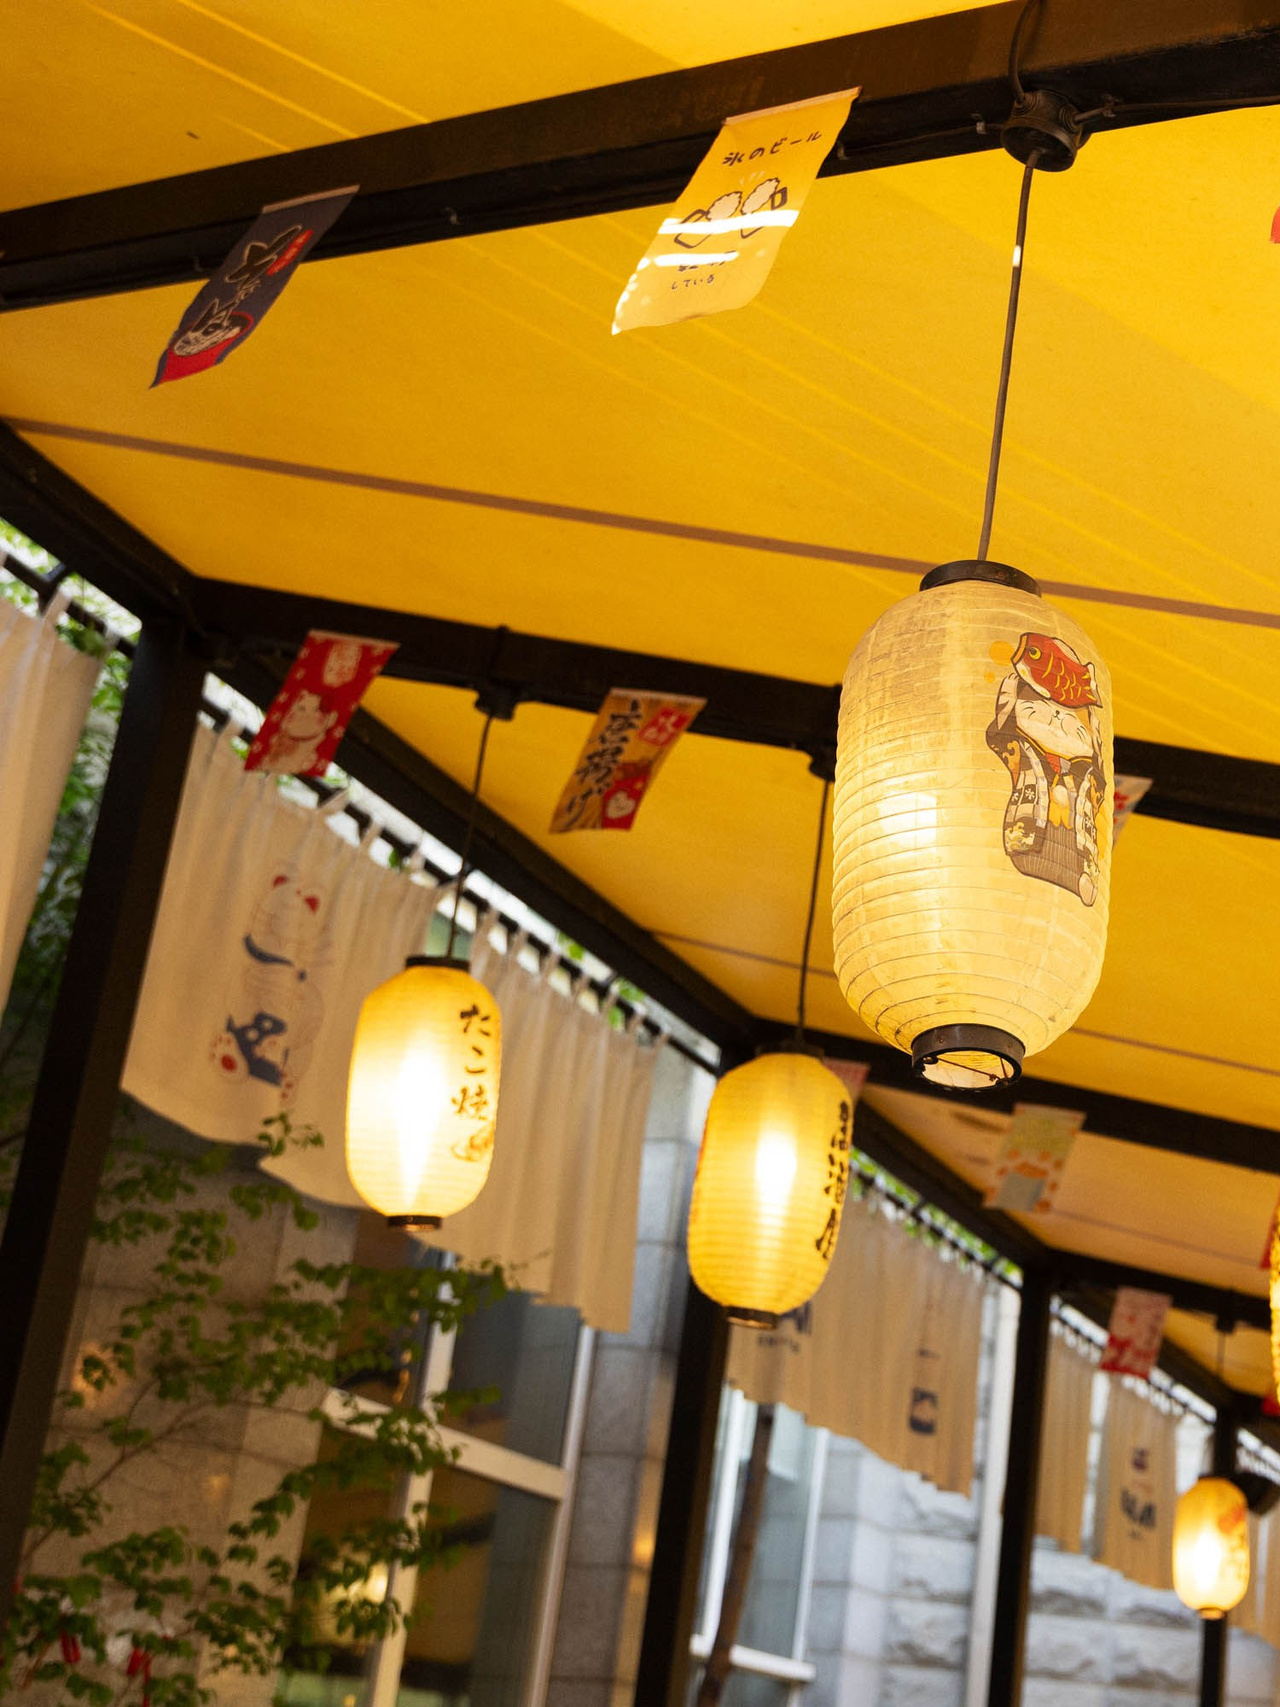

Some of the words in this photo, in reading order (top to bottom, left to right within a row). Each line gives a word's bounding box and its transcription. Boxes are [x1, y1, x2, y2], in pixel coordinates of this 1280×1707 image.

[721, 130, 823, 167] 氷のビール
